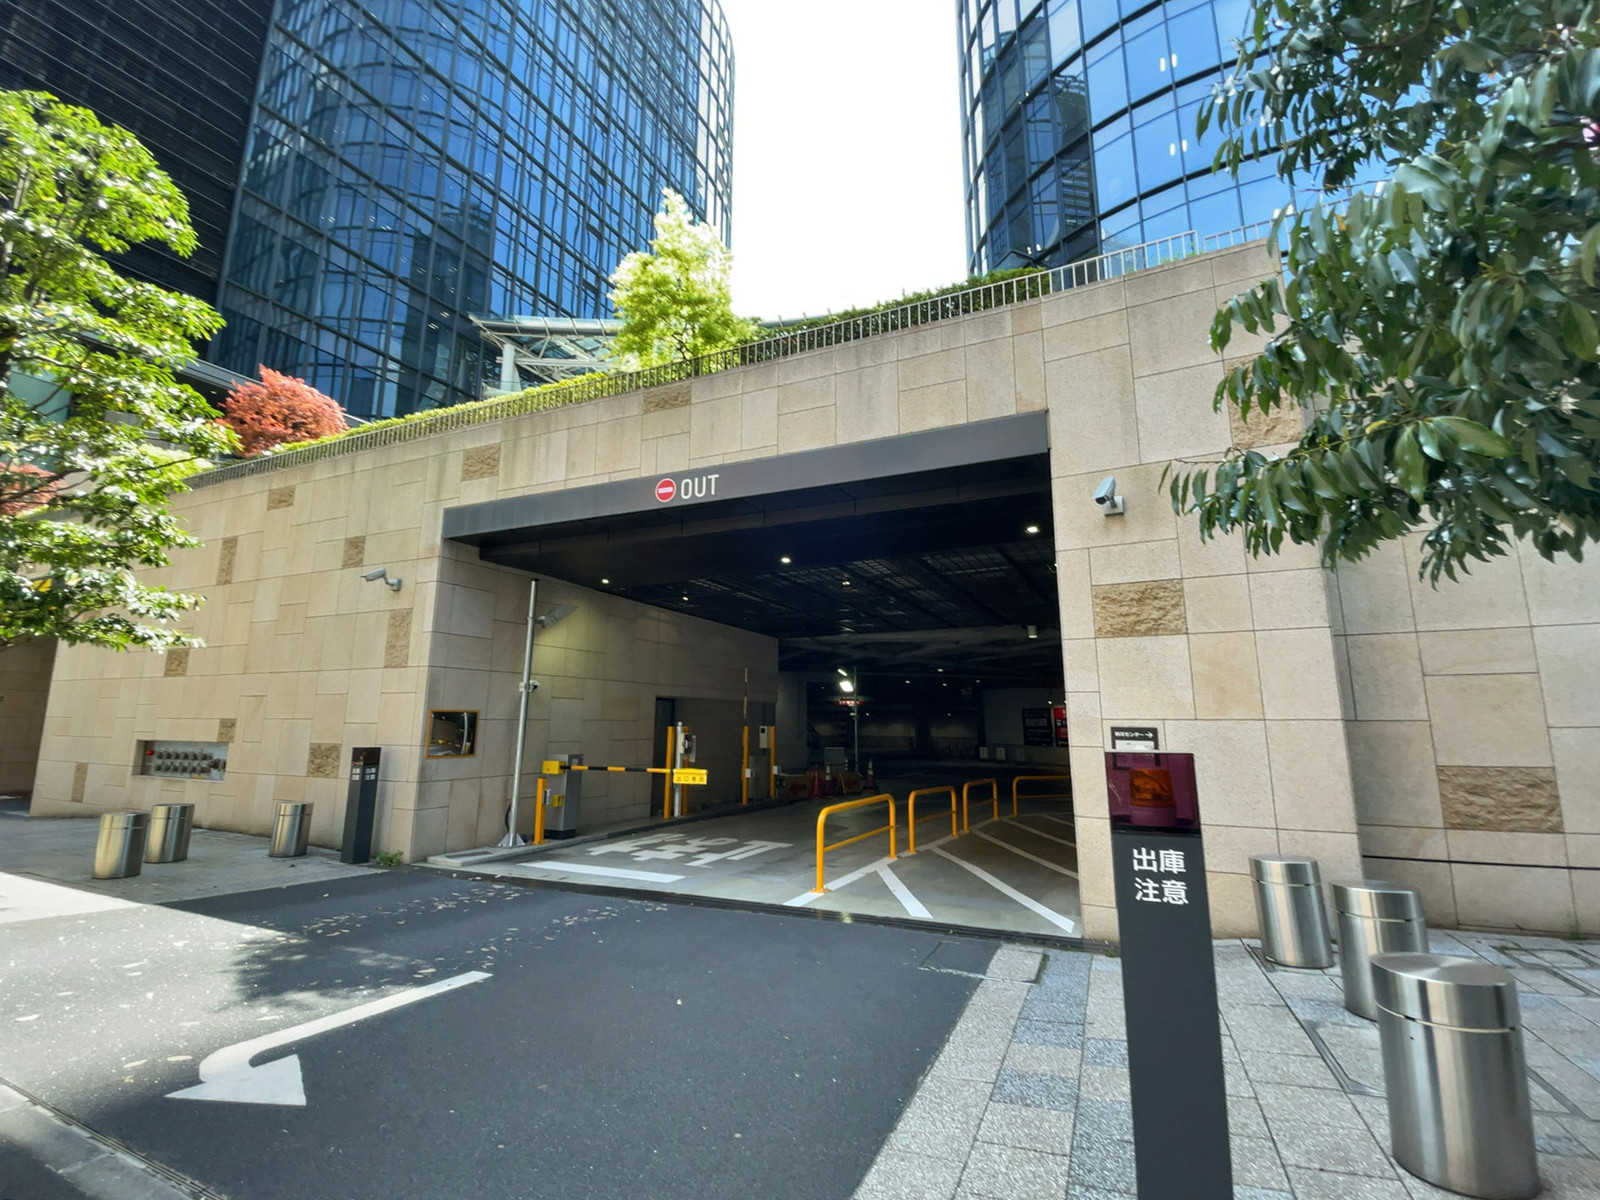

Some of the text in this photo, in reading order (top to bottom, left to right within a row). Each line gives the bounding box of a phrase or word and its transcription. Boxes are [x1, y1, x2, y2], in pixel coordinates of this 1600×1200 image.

[681, 474, 719, 499] OUT
[585, 832, 795, 868] 止まれ
[1132, 847, 1187, 874] 出庫
[1134, 877, 1189, 905] 注意
